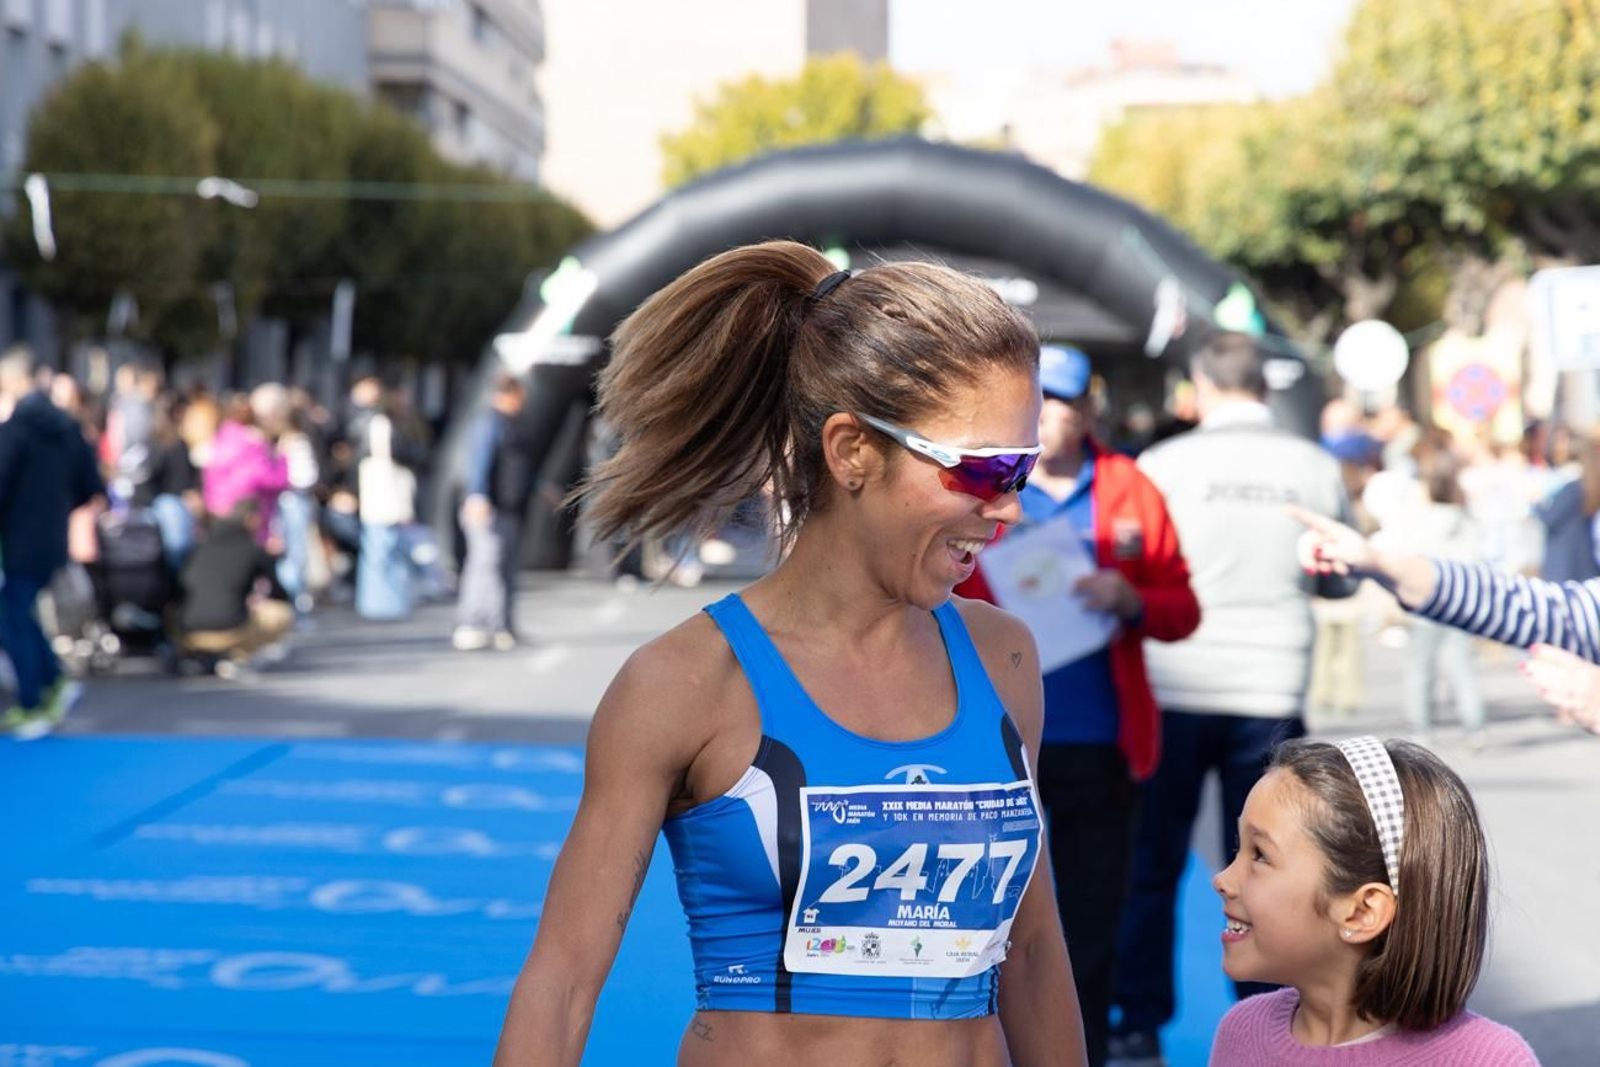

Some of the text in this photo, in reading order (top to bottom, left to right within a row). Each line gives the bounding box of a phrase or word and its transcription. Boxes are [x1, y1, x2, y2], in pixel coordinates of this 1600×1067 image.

[882, 801, 903, 810] XXIX
[906, 801, 932, 810] MEDIA
[935, 799, 974, 810] MARATÓN
[1006, 798, 1014, 807] DE
[883, 812, 888, 821] Y
[893, 812, 908, 821] 10K
[912, 812, 924, 821] EN
[928, 811, 963, 821] MEMORIA
[967, 811, 977, 821] DE
[981, 810, 998, 820] PACO
[818, 838, 1028, 905] 2477
[897, 903, 950, 920] MARÍA
[888, 919, 918, 927] MOYANO
[933, 920, 957, 928] MORAL
